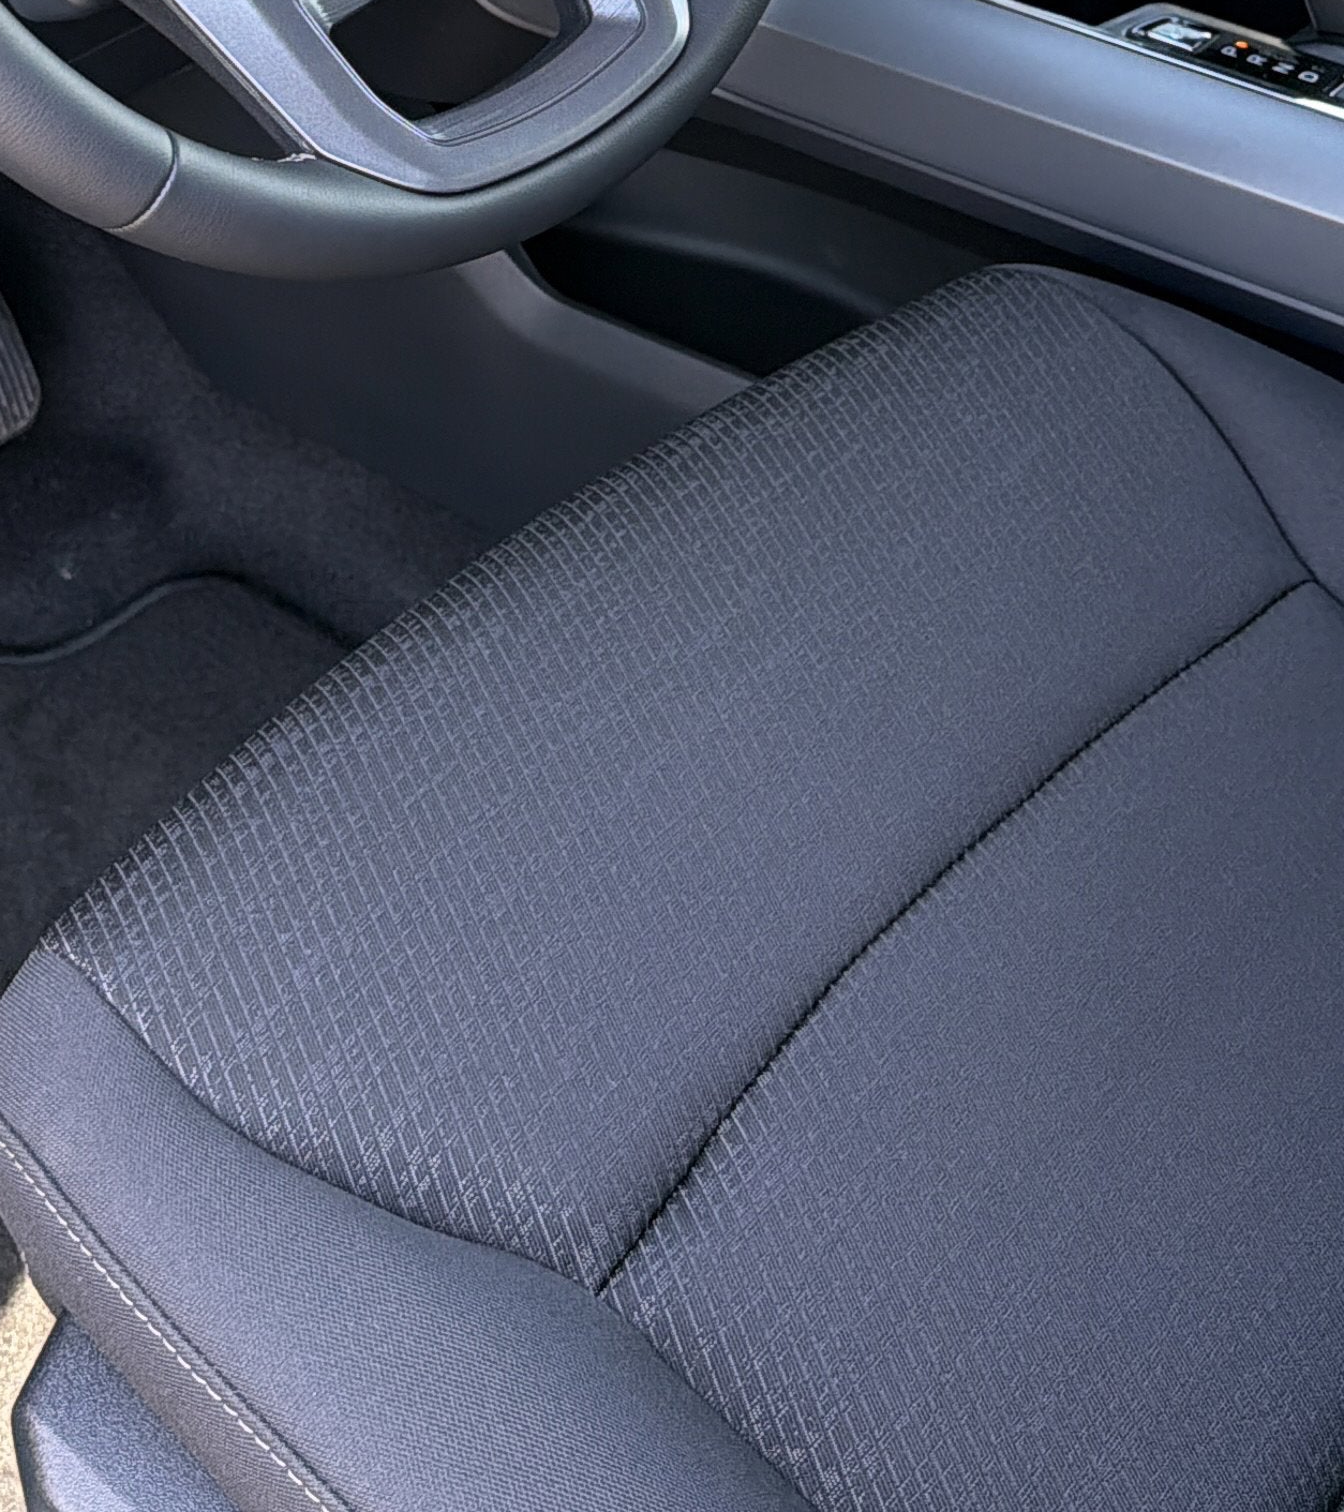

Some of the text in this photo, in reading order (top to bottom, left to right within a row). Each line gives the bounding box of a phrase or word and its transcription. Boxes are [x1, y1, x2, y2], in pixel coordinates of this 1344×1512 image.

[1220, 46, 1238, 59] P
[1246, 53, 1268, 67] R
[1271, 62, 1295, 75] N
[1297, 71, 1319, 84] D
